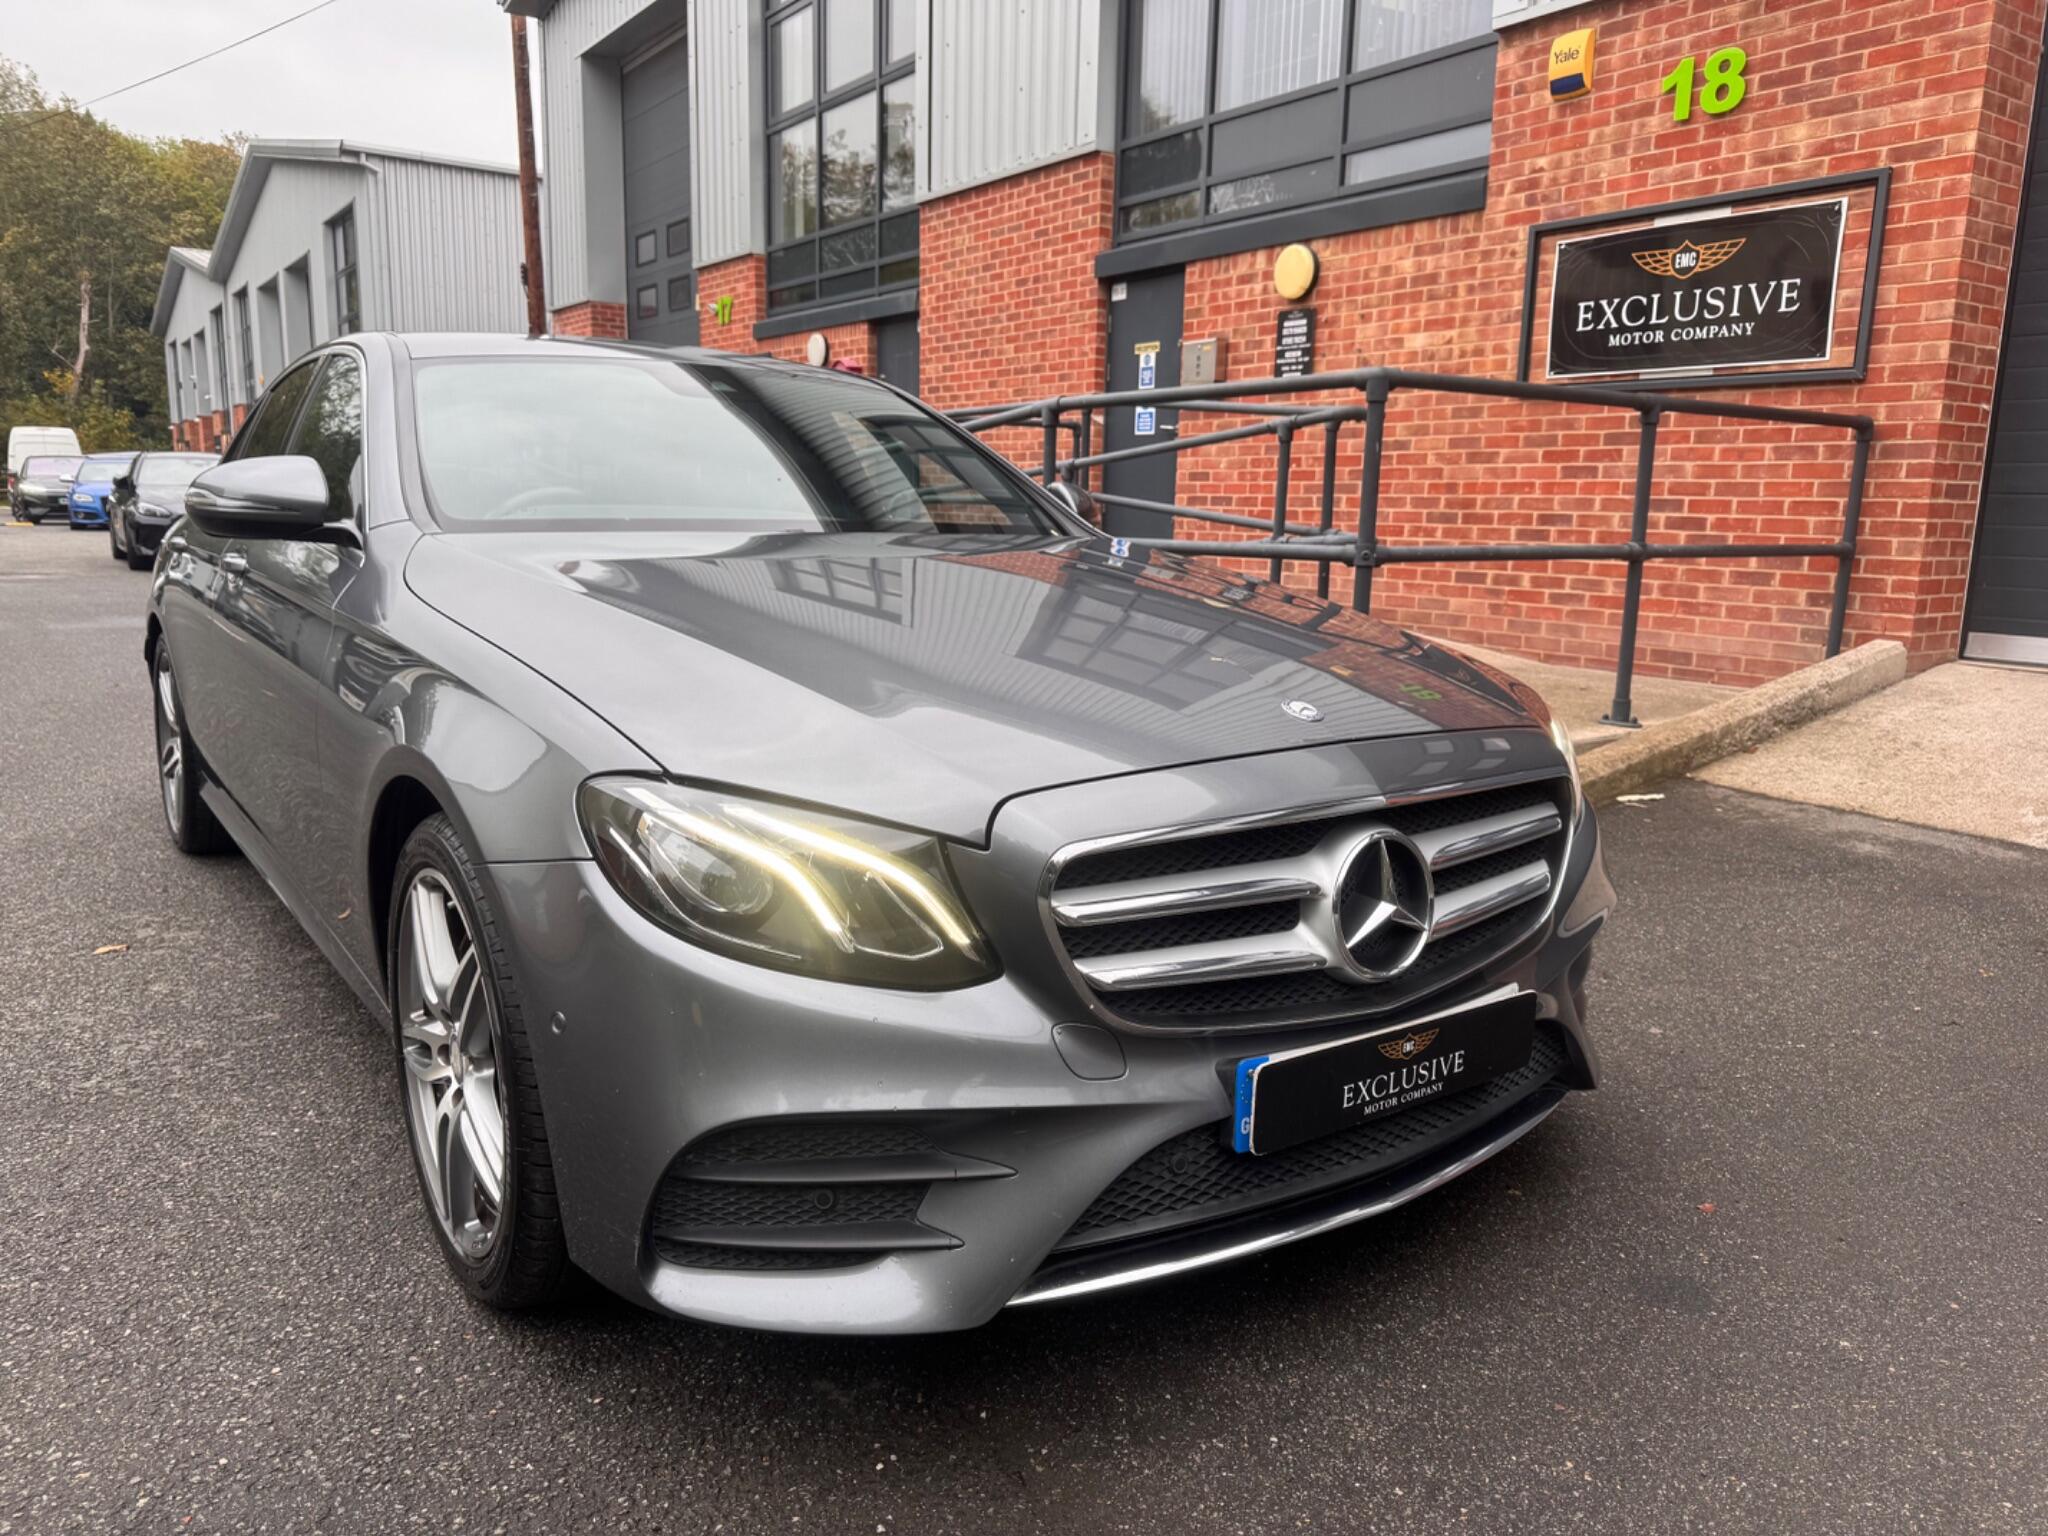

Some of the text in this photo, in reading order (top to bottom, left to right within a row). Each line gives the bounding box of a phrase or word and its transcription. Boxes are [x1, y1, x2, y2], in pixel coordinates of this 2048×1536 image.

[1554, 48, 1580, 64] Yale
[1662, 47, 1746, 121] 18
[1675, 251, 1697, 269] EMC
[715, 296, 733, 325] 17
[1576, 278, 1802, 332] EXCLUSIVE
[1608, 322, 1756, 347] MOTOR COMPANY
[1342, 1050, 1465, 1108] EXCLUSIVE
[1363, 1081, 1444, 1116] MOTOR COMPANY
